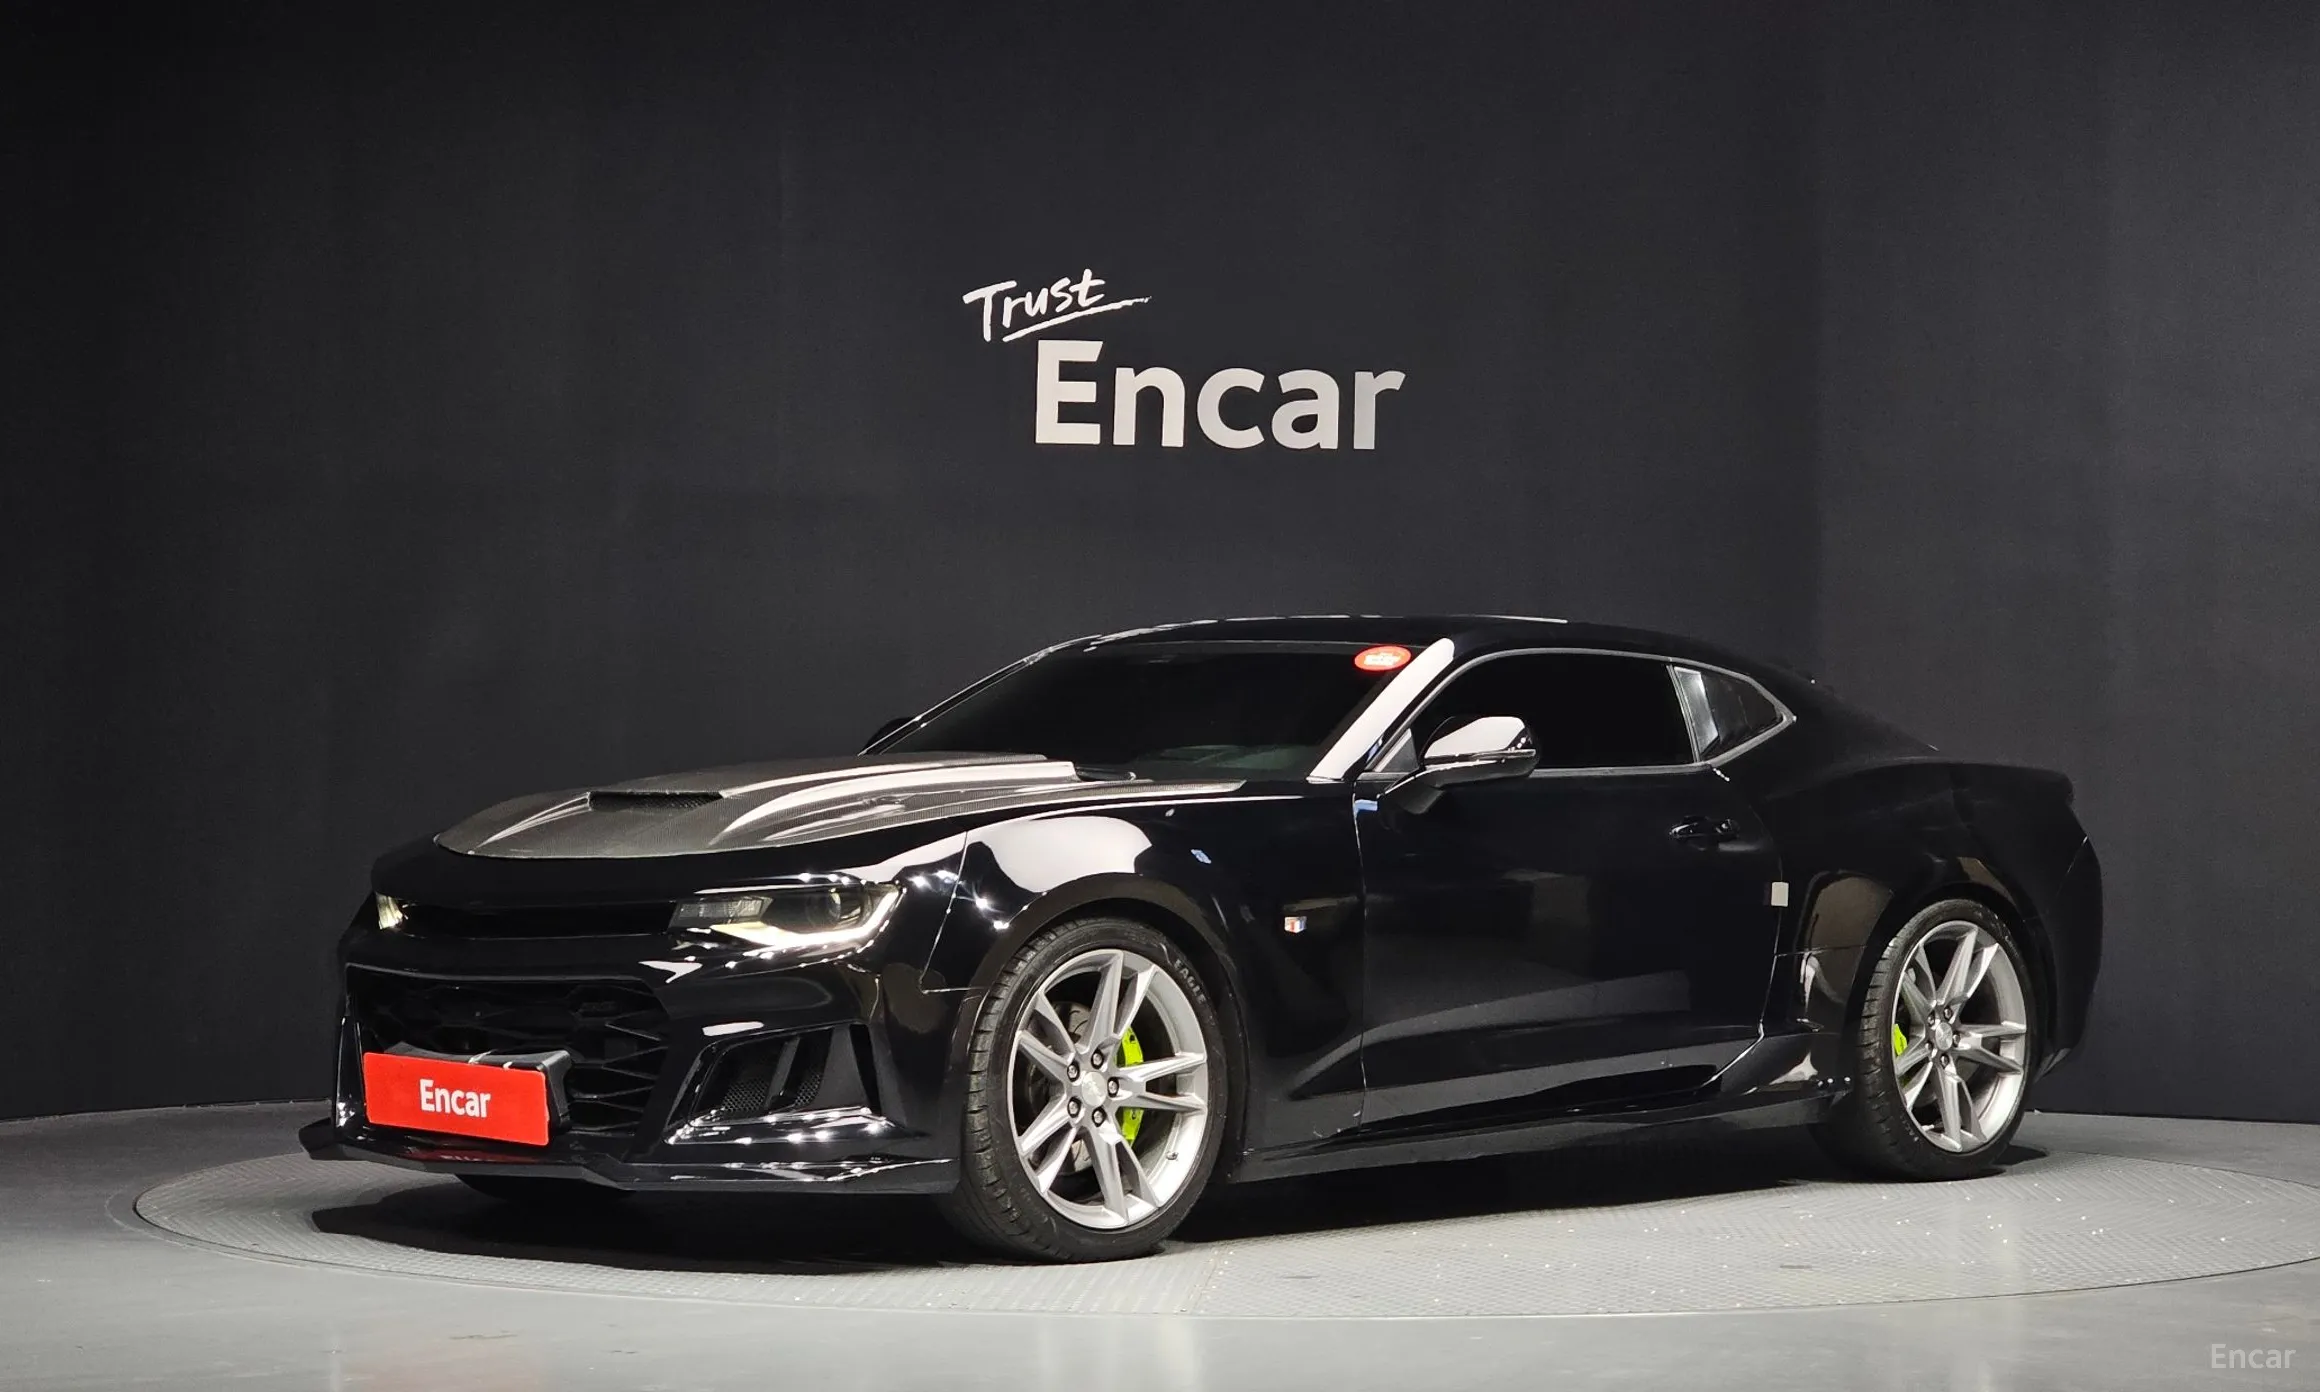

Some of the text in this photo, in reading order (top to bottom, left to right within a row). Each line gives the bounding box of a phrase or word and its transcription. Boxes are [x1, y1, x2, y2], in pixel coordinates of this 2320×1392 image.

[962, 268, 1107, 343] Trust
[1035, 340, 1406, 450] Encar
[1173, 959, 1207, 1005] EAGLE
[419, 1078, 491, 1118] Encar
